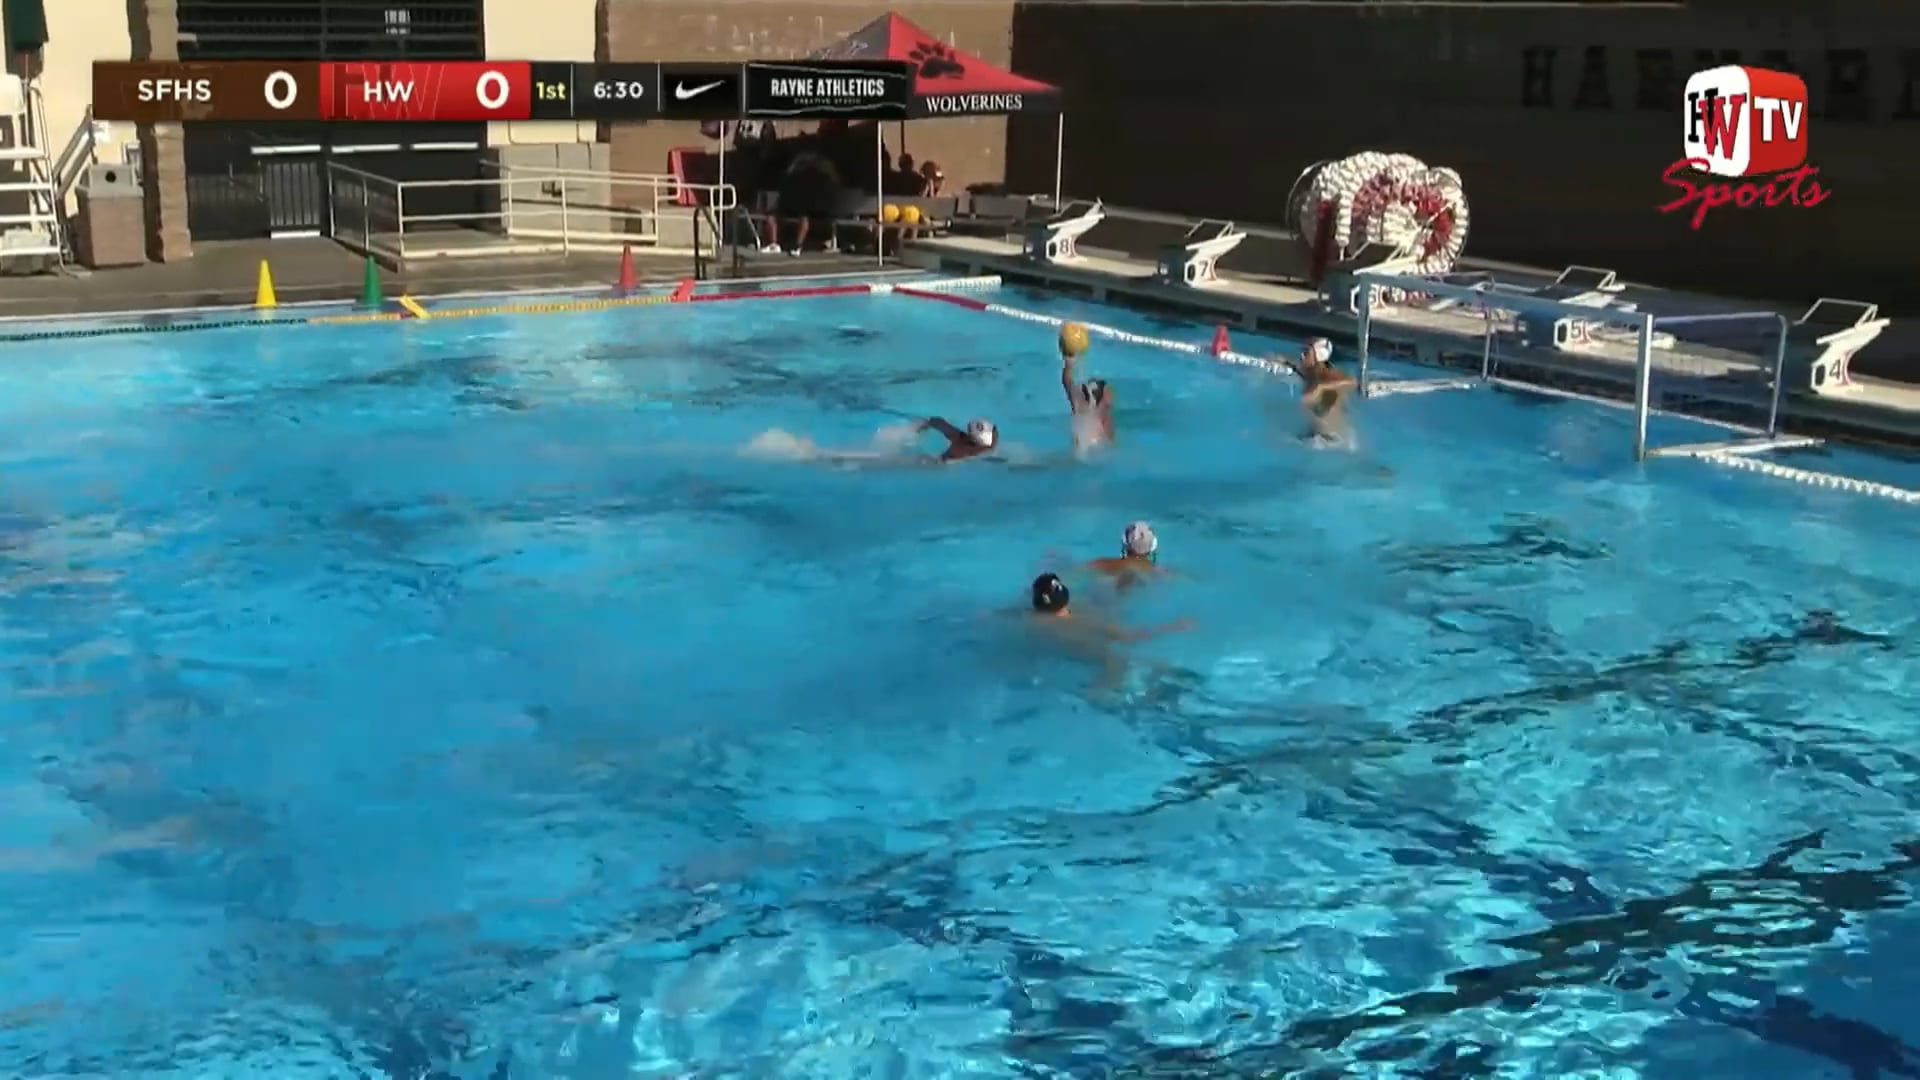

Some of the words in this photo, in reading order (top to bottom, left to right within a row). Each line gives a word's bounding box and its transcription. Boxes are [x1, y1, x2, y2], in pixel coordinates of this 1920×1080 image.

[926, 94, 1023, 113] WOLVERINES
[1060, 239, 1069, 252] 8
[1200, 260, 1209, 277] 7
[1571, 319, 1582, 338] 5
[1829, 359, 1841, 380] 4
